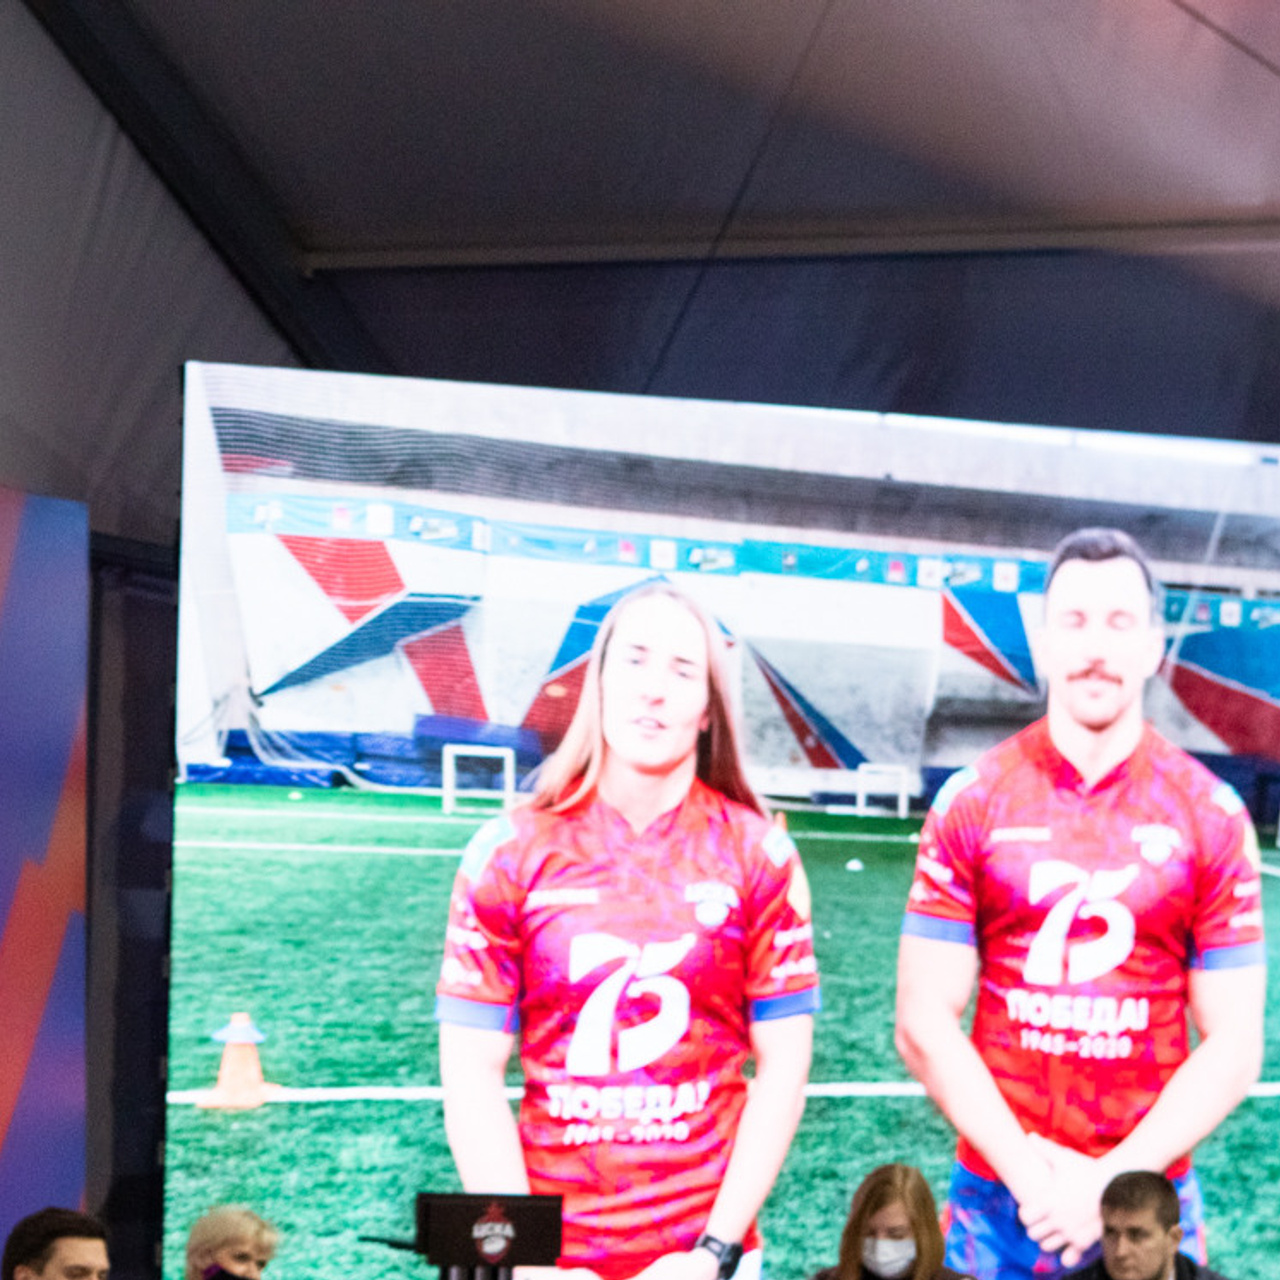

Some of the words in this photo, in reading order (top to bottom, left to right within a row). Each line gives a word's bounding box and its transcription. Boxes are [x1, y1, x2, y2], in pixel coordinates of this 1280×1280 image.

[1021, 859, 1141, 987] 75
[564, 931, 698, 1078] 75
[1005, 988, 1150, 1036] ПОБЕДА!
[545, 1080, 711, 1126] ПОБЕДА!
